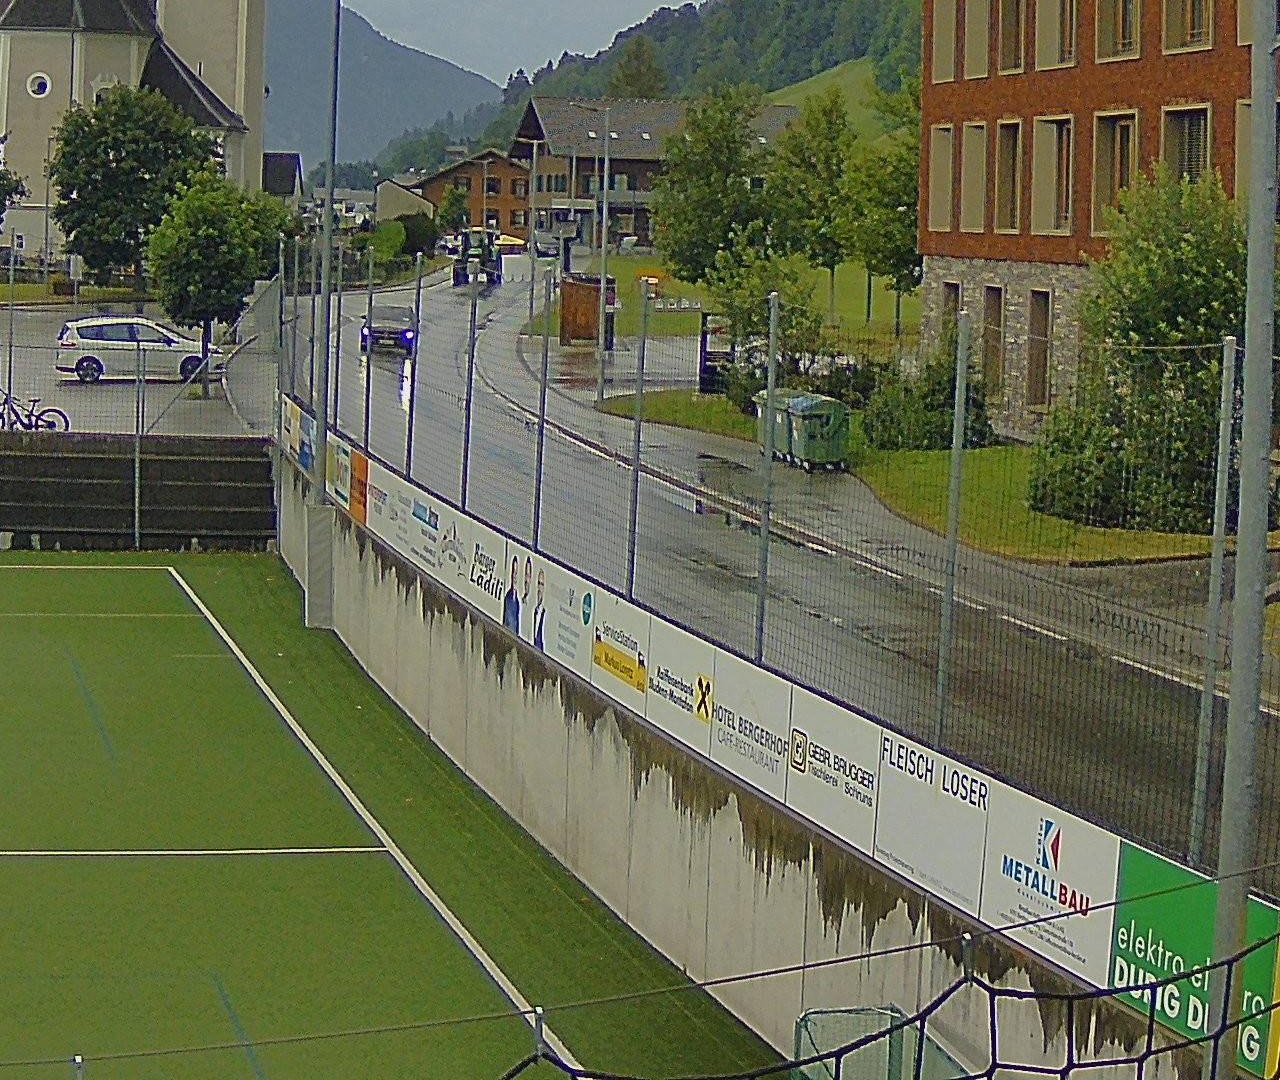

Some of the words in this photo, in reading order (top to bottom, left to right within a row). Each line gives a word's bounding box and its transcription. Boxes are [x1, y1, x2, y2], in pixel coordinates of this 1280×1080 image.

[712, 701, 736, 731] HOTEL
[739, 716, 790, 758] BERGERHOF
[844, 781, 873, 808] Schruns
[881, 735, 935, 785] FLEISCH
[941, 765, 988, 812] LOSER
[1001, 854, 1091, 917] METALLBAU
[1117, 919, 1184, 976] elektro
